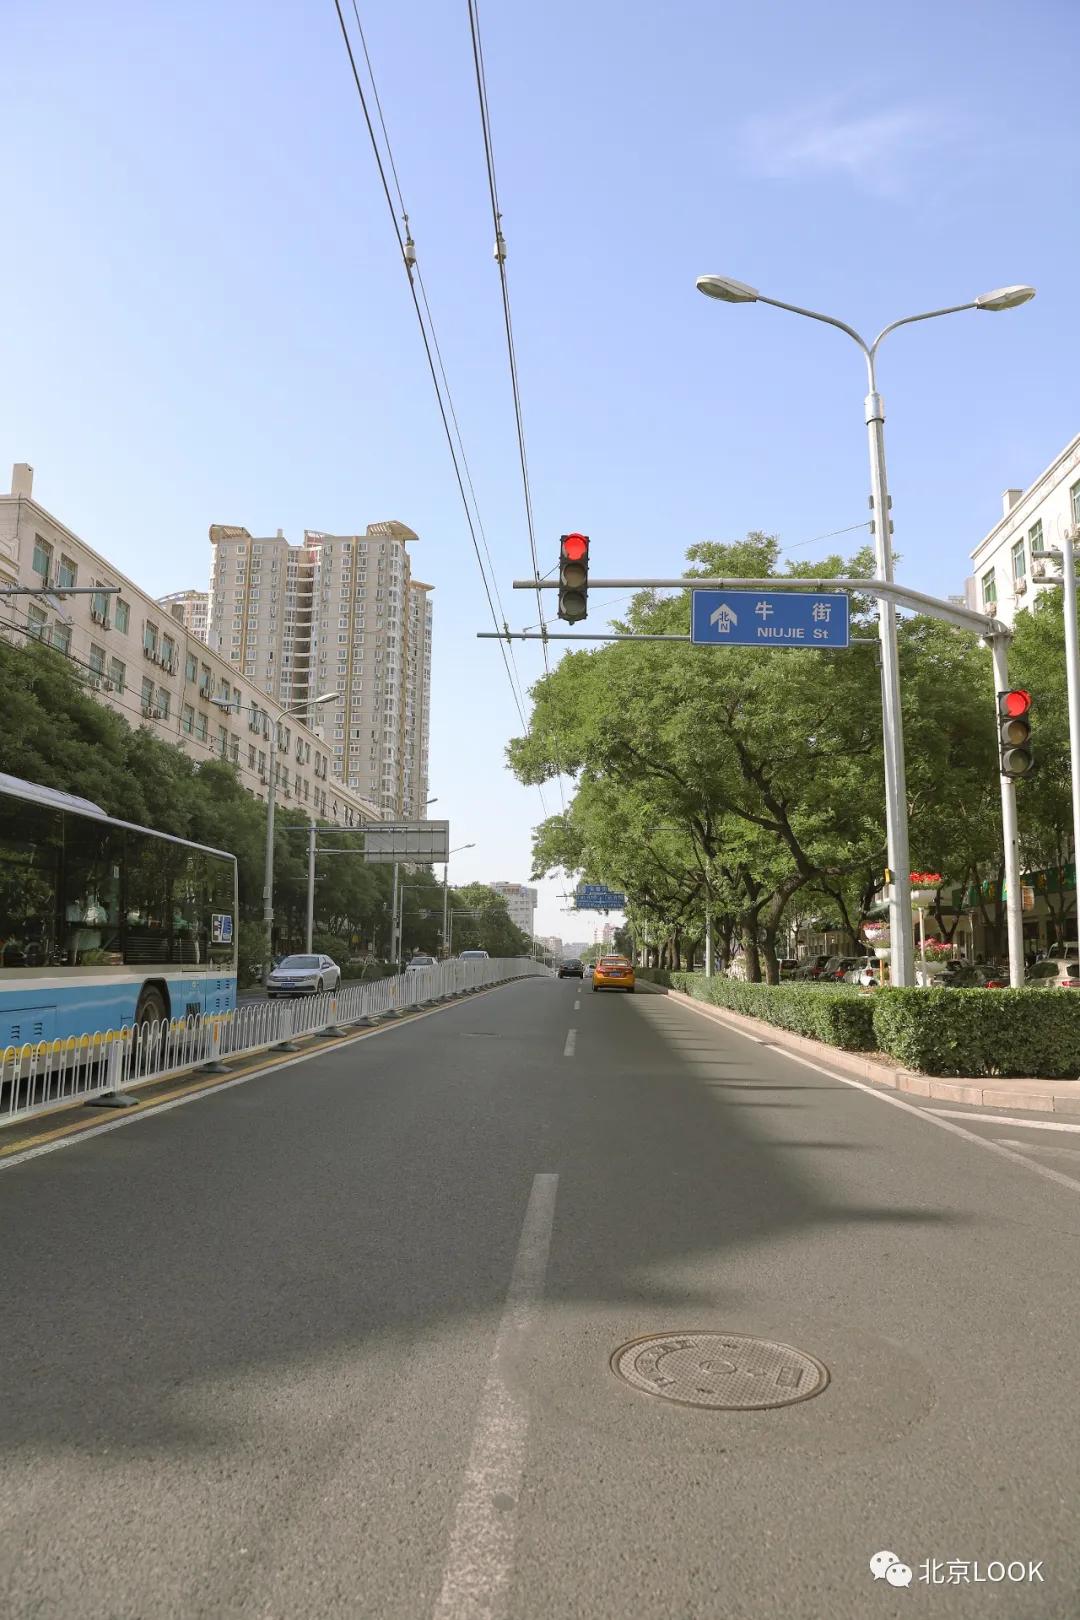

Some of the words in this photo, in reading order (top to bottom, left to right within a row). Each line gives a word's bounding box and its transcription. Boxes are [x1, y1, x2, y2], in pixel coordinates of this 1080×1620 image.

[719, 610, 730, 622] 北
[720, 623, 729, 631] N
[757, 627, 805, 639] NIUJIE
[813, 628, 829, 639] St
